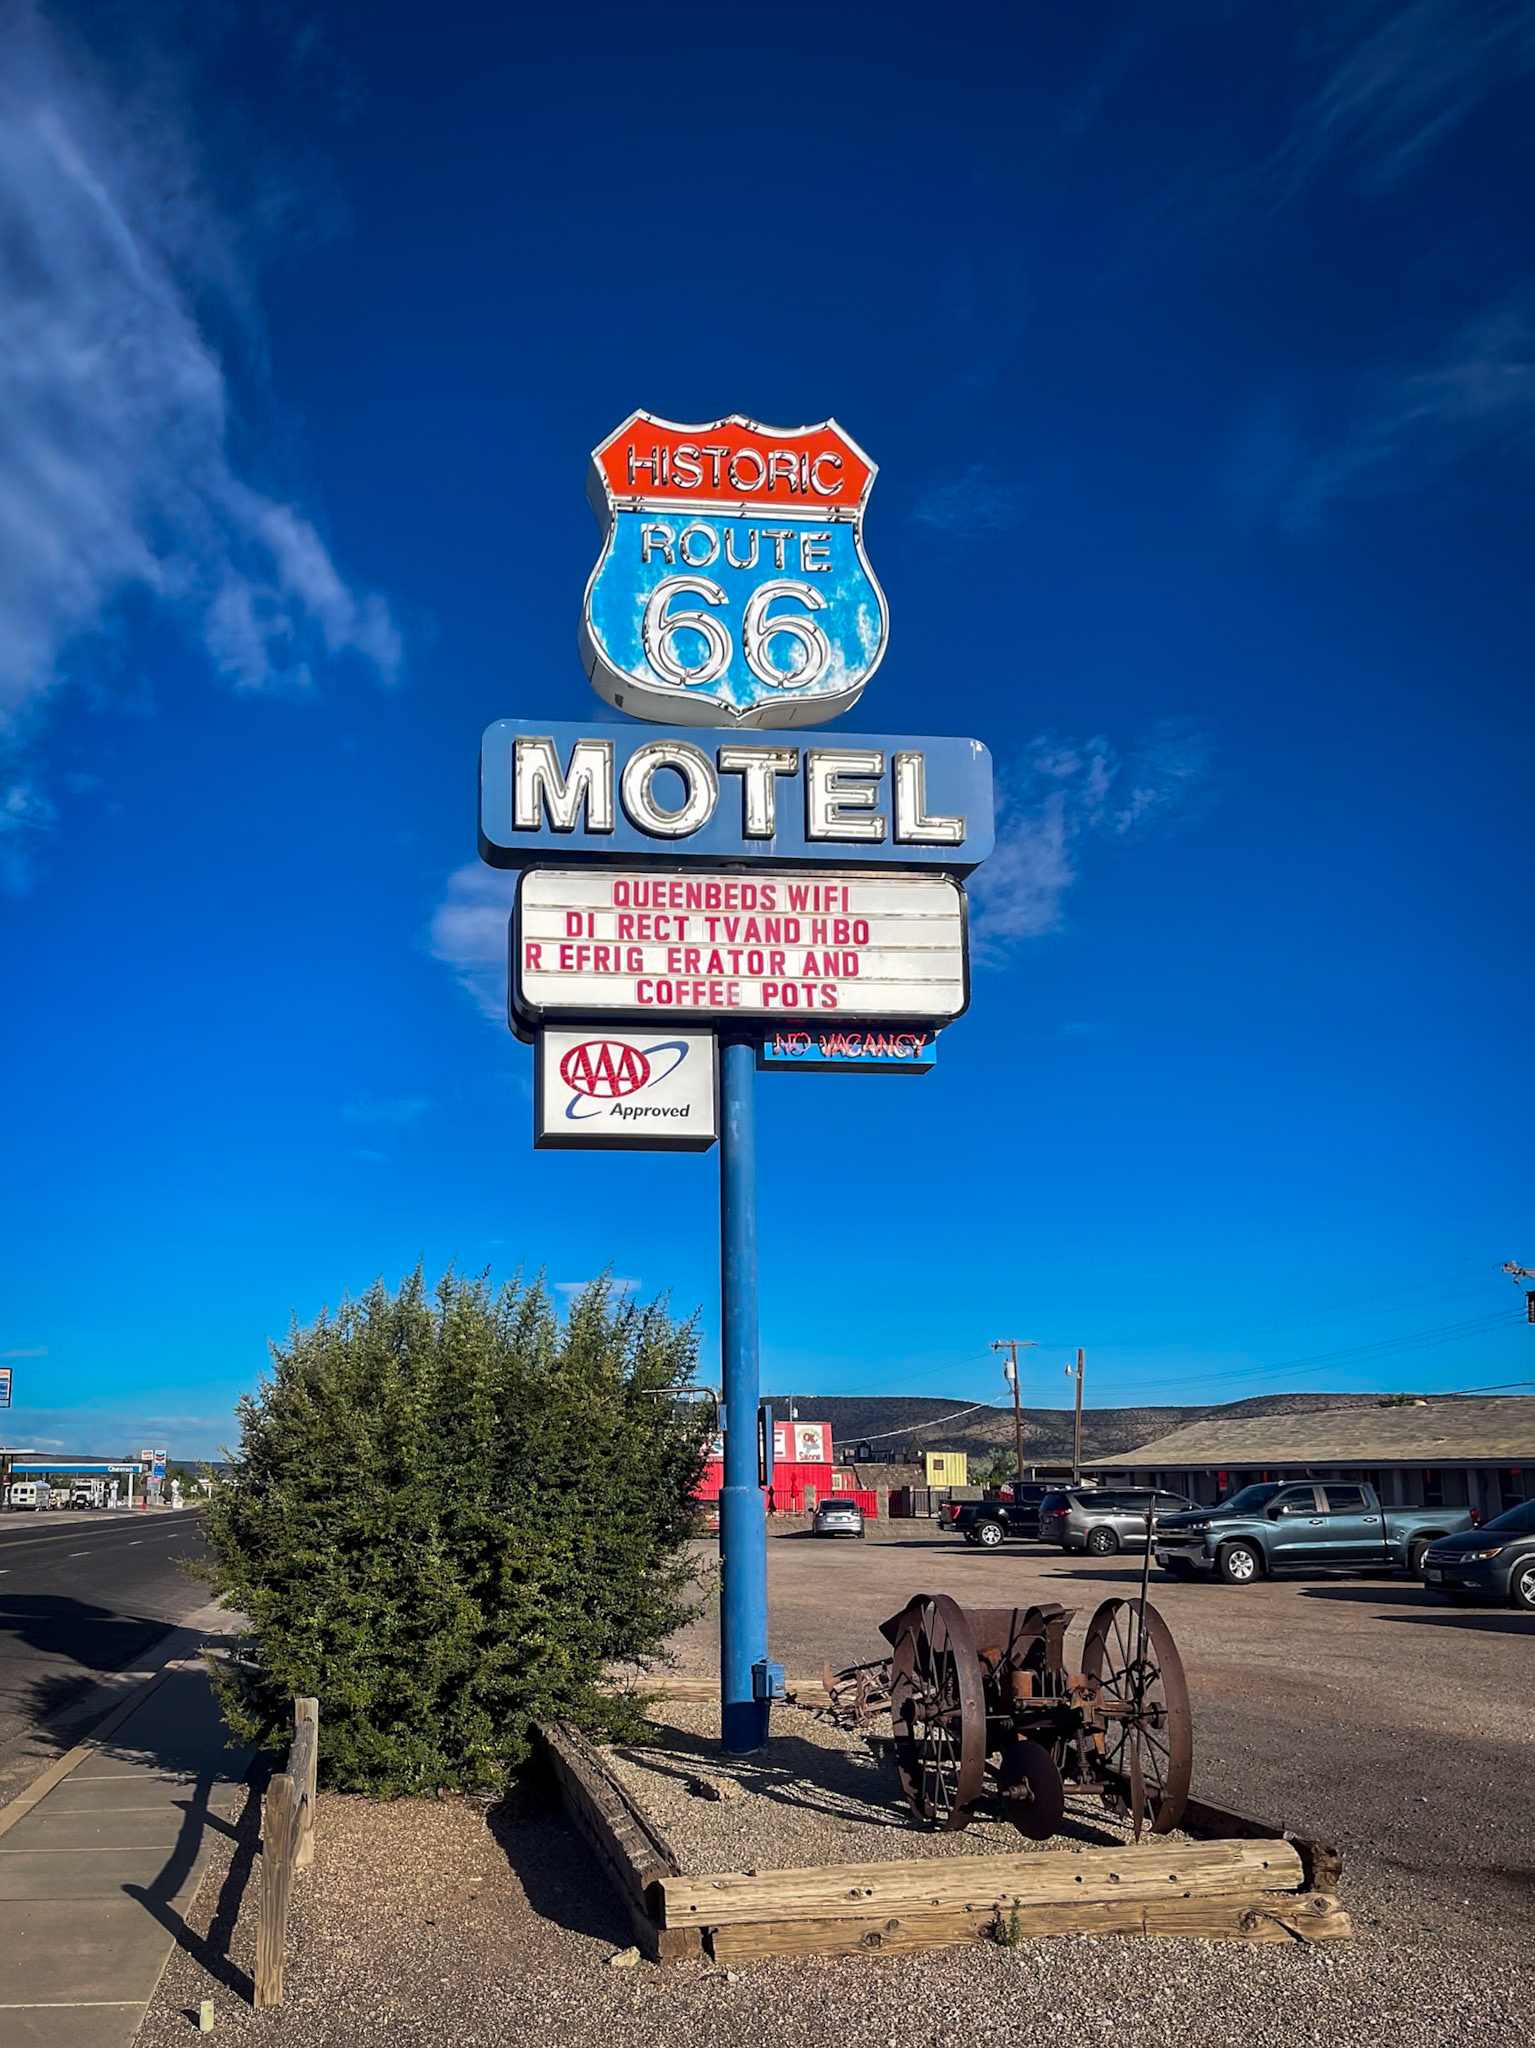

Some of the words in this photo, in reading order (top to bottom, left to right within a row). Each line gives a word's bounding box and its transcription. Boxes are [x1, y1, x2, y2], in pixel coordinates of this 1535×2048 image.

[627, 443, 844, 496] HISTORIC
[640, 522, 834, 573] ROUTE
[642, 574, 830, 689] 66
[512, 735, 966, 847] MOTEL
[787, 885, 850, 913] WIFI
[812, 919, 870, 946] HBO
[803, 951, 859, 977] AND
[637, 979, 741, 1007] COFFEE
[762, 982, 839, 1008] POTS
[773, 1032, 812, 1057] NO
[819, 1032, 927, 1059] VACANCY
[568, 1043, 642, 1097] AAA
[609, 1102, 690, 1120] Approved
[803, 1432, 816, 1444] OK
